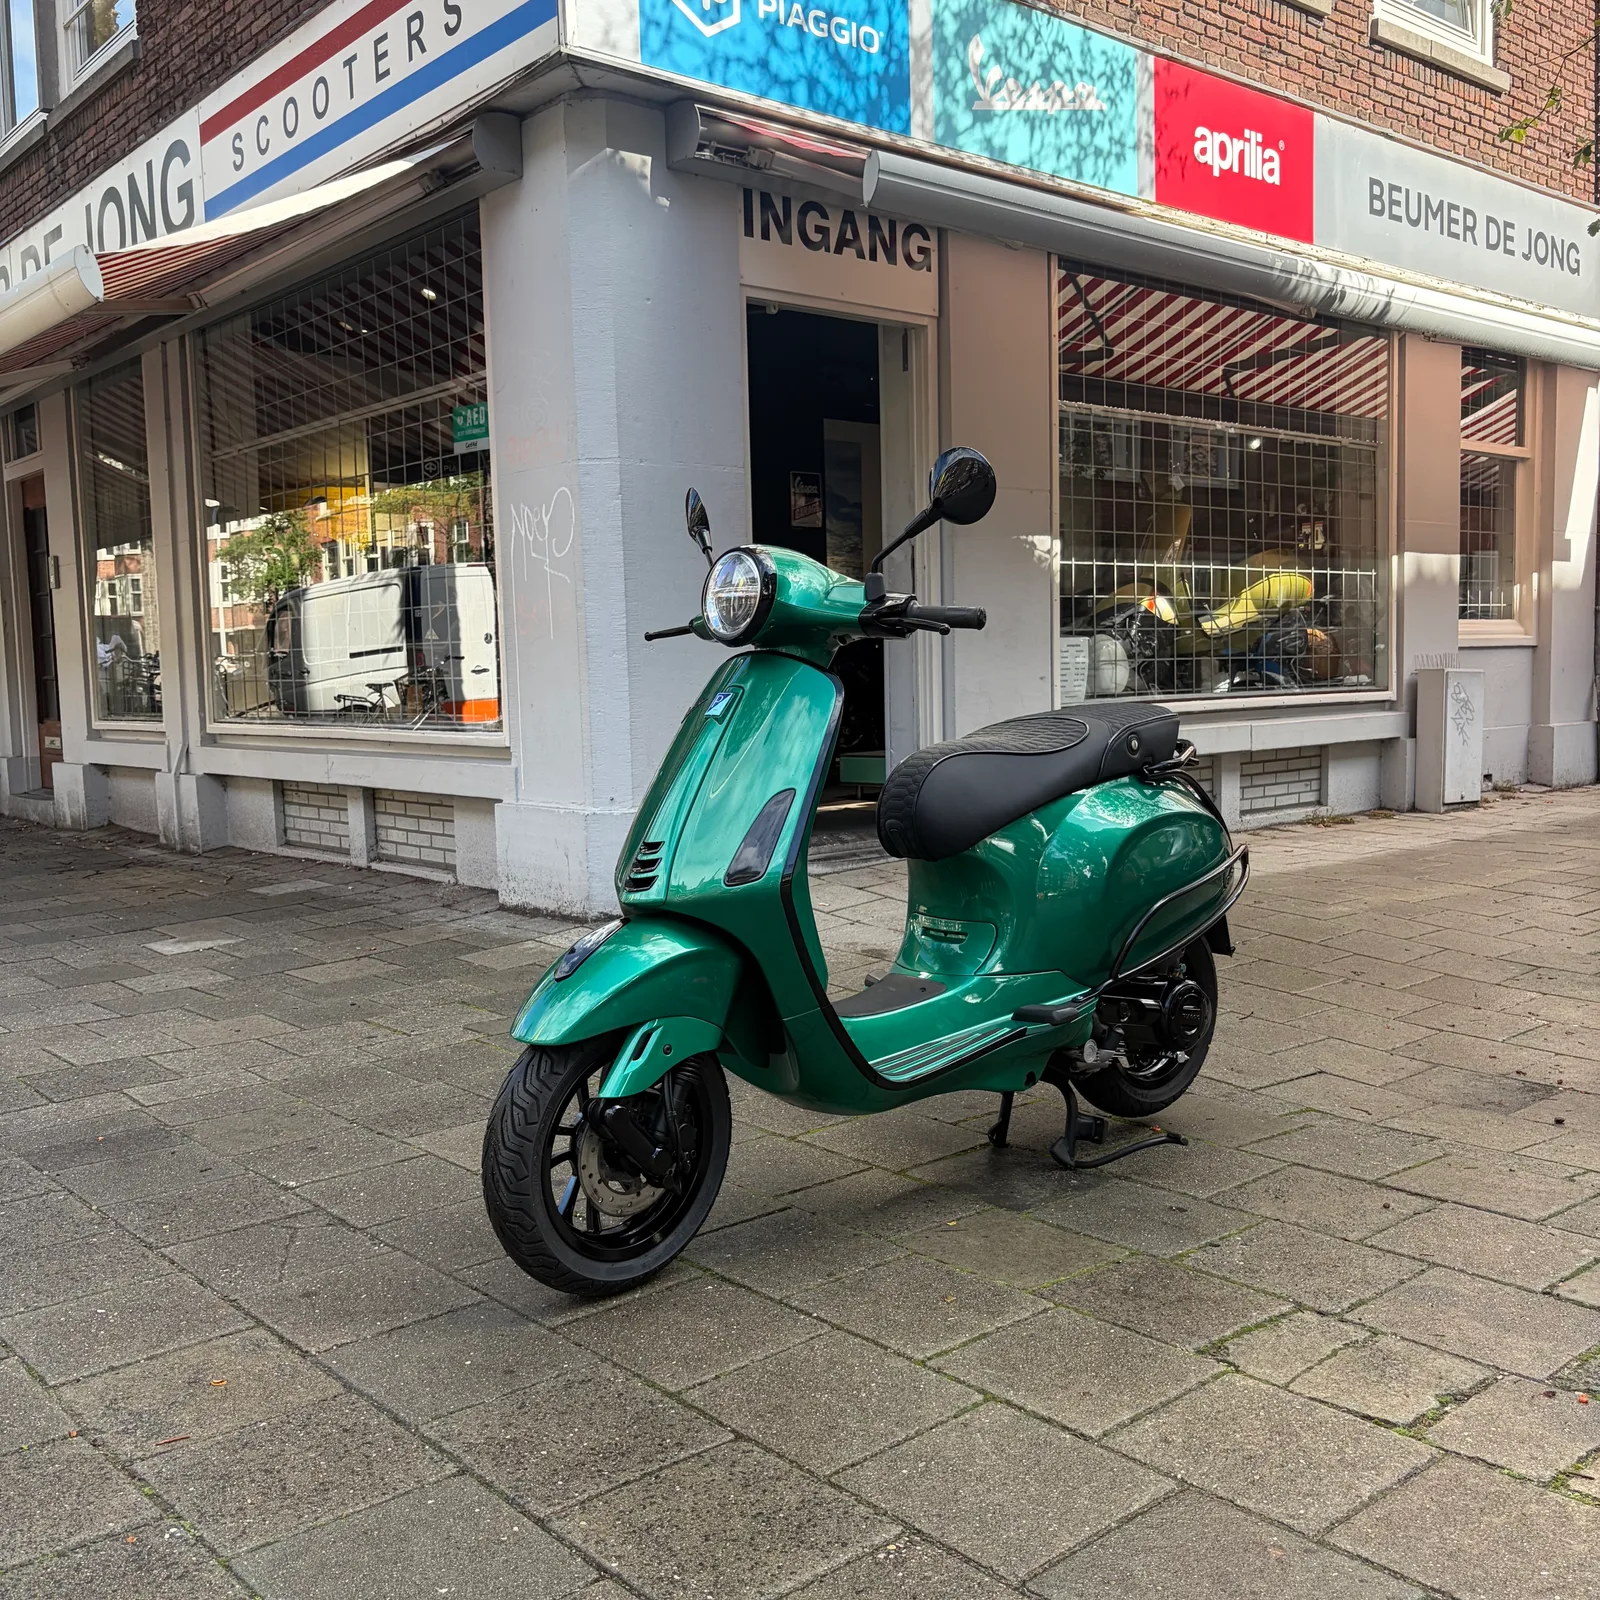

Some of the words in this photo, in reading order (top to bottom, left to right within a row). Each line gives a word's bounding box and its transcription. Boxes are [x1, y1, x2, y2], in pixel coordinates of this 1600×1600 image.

[758, 0, 880, 54] PIAGGIO
[232, 0, 462, 172] SCOOTERS
[968, 33, 1107, 115] Vespa
[1193, 126, 1280, 186] aprilia
[743, 187, 932, 273] INGANG
[1369, 177, 1478, 246] BEUMER
[1485, 214, 1516, 257] DE
[1522, 228, 1581, 277] JONG
[466, 406, 485, 427] AED
